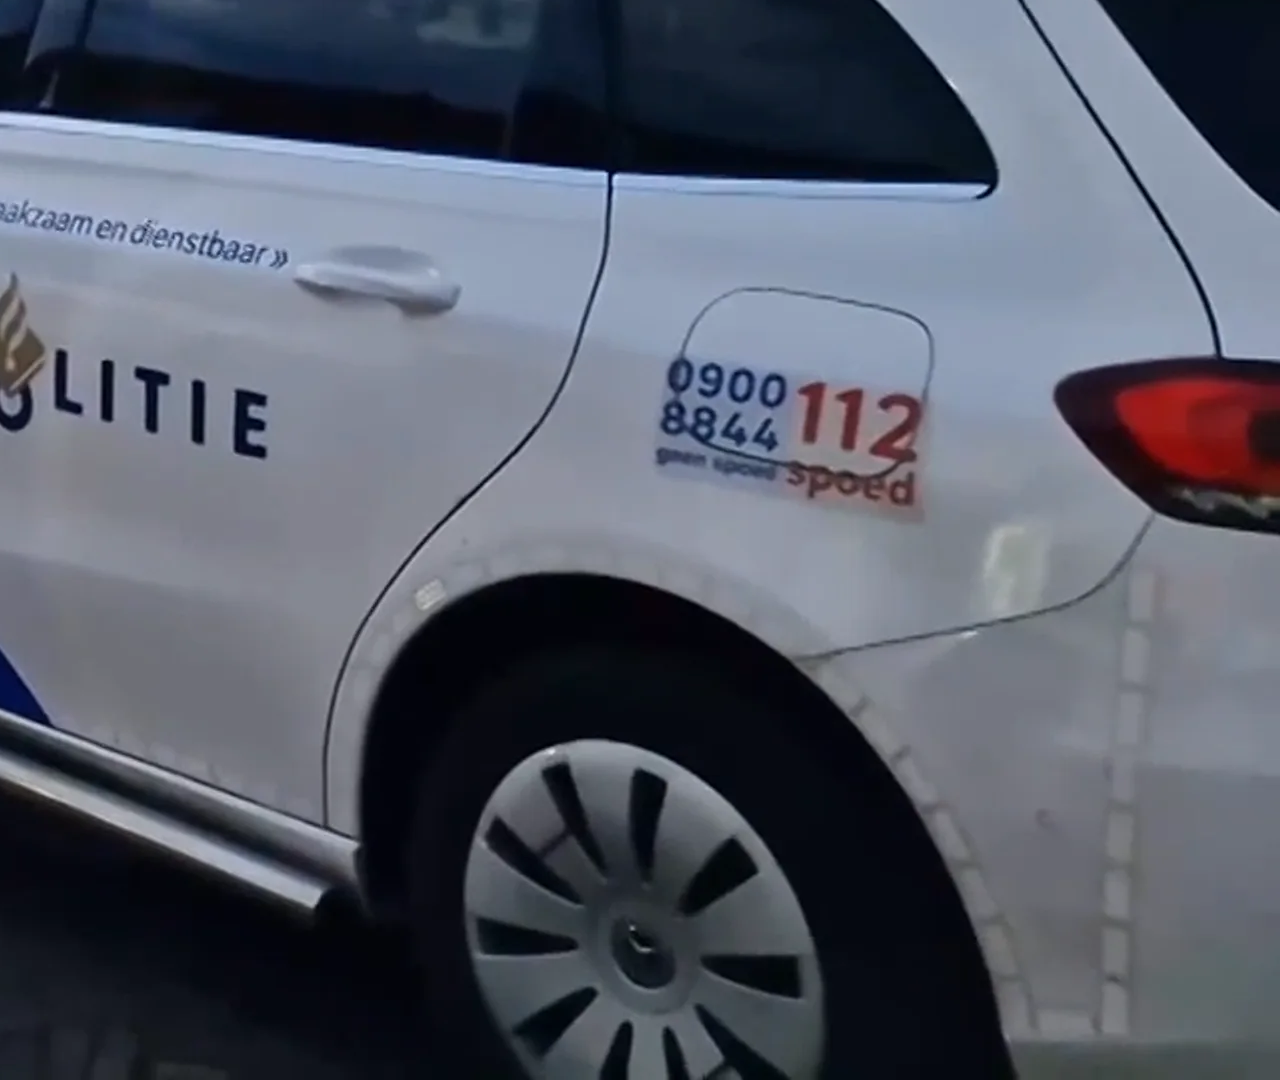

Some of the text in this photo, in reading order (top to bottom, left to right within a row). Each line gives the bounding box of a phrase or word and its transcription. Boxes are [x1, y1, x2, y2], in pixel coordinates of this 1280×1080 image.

[95, 218, 128, 243] en
[668, 357, 787, 409] 0900
[659, 399, 779, 452] 8844
[796, 380, 923, 462] 112
[785, 460, 915, 506] spoed
